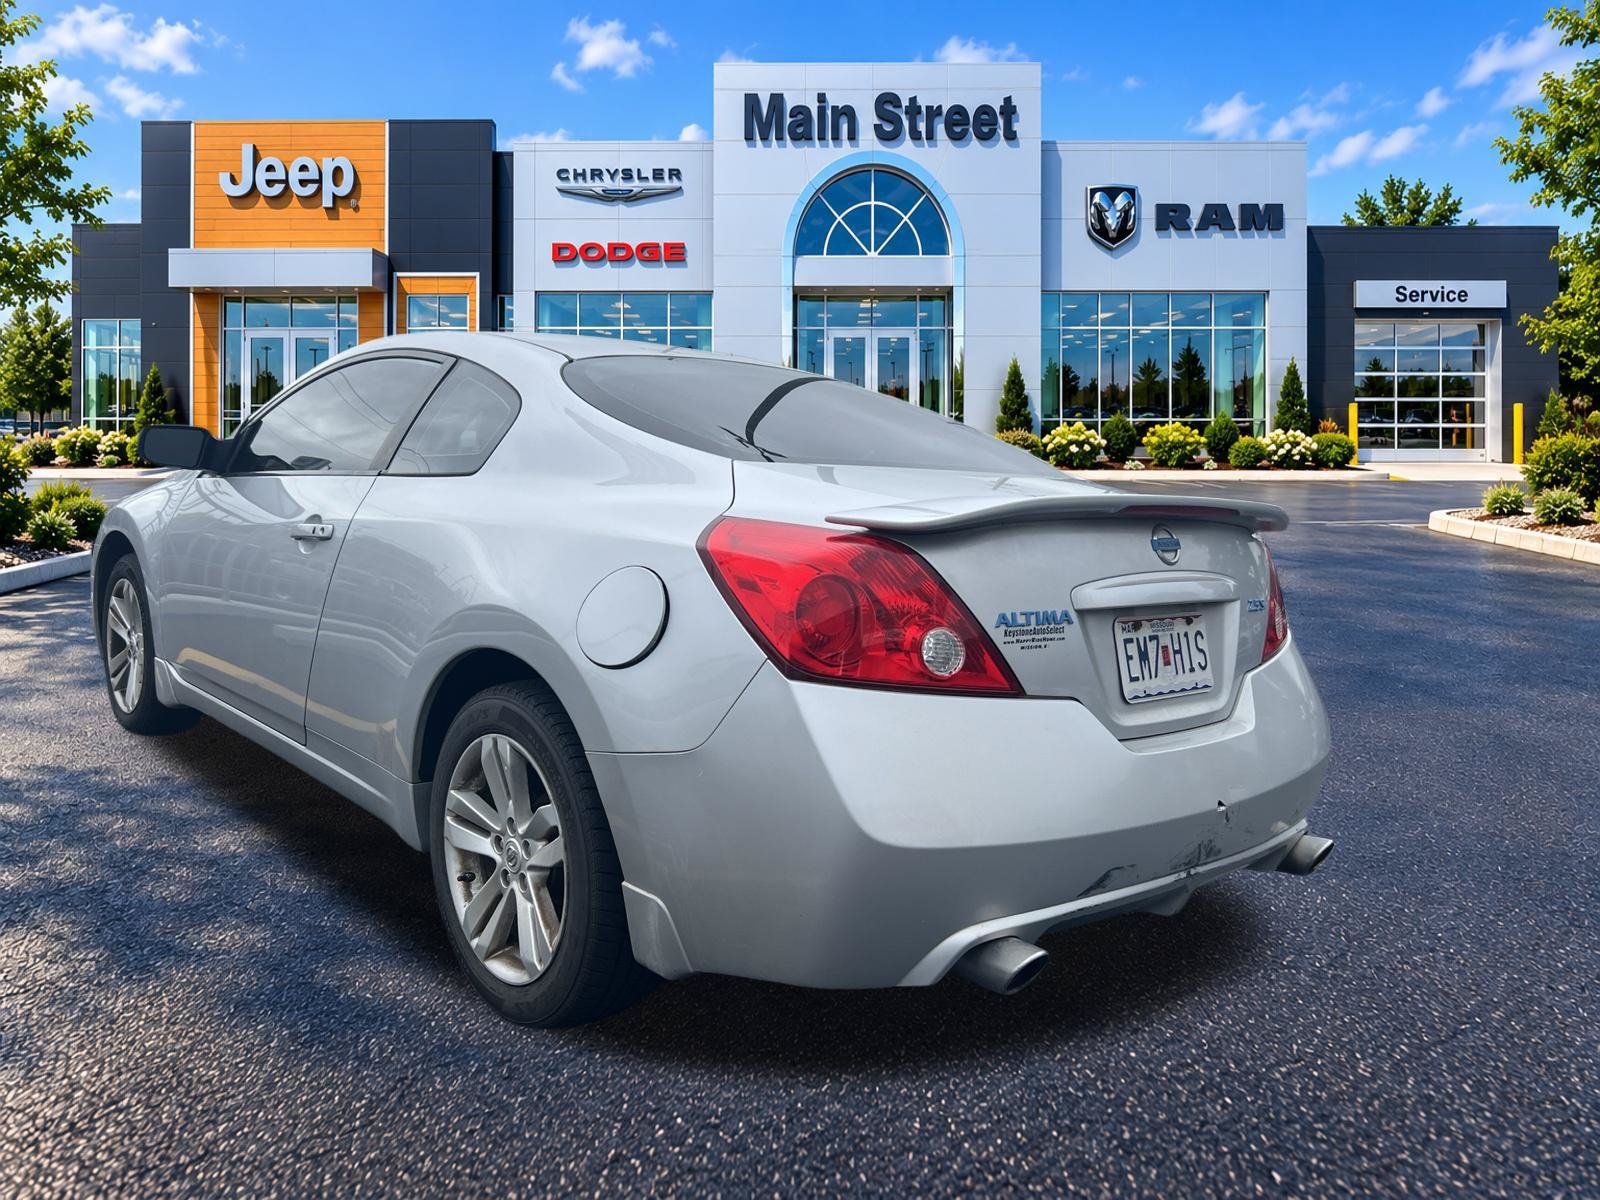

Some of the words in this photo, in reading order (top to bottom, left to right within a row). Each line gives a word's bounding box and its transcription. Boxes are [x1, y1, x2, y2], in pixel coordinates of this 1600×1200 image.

[743, 92, 857, 142] Main
[874, 92, 1018, 142] Street
[219, 143, 355, 209] Jeep
[556, 167, 682, 184] CHRYSLER
[1155, 202, 1284, 232] RAM
[551, 241, 687, 263] DODGE
[1395, 285, 1469, 304] Service
[995, 610, 1074, 628] ALTIMA
[1003, 626, 1065, 638] KeystoneAutoSelect
